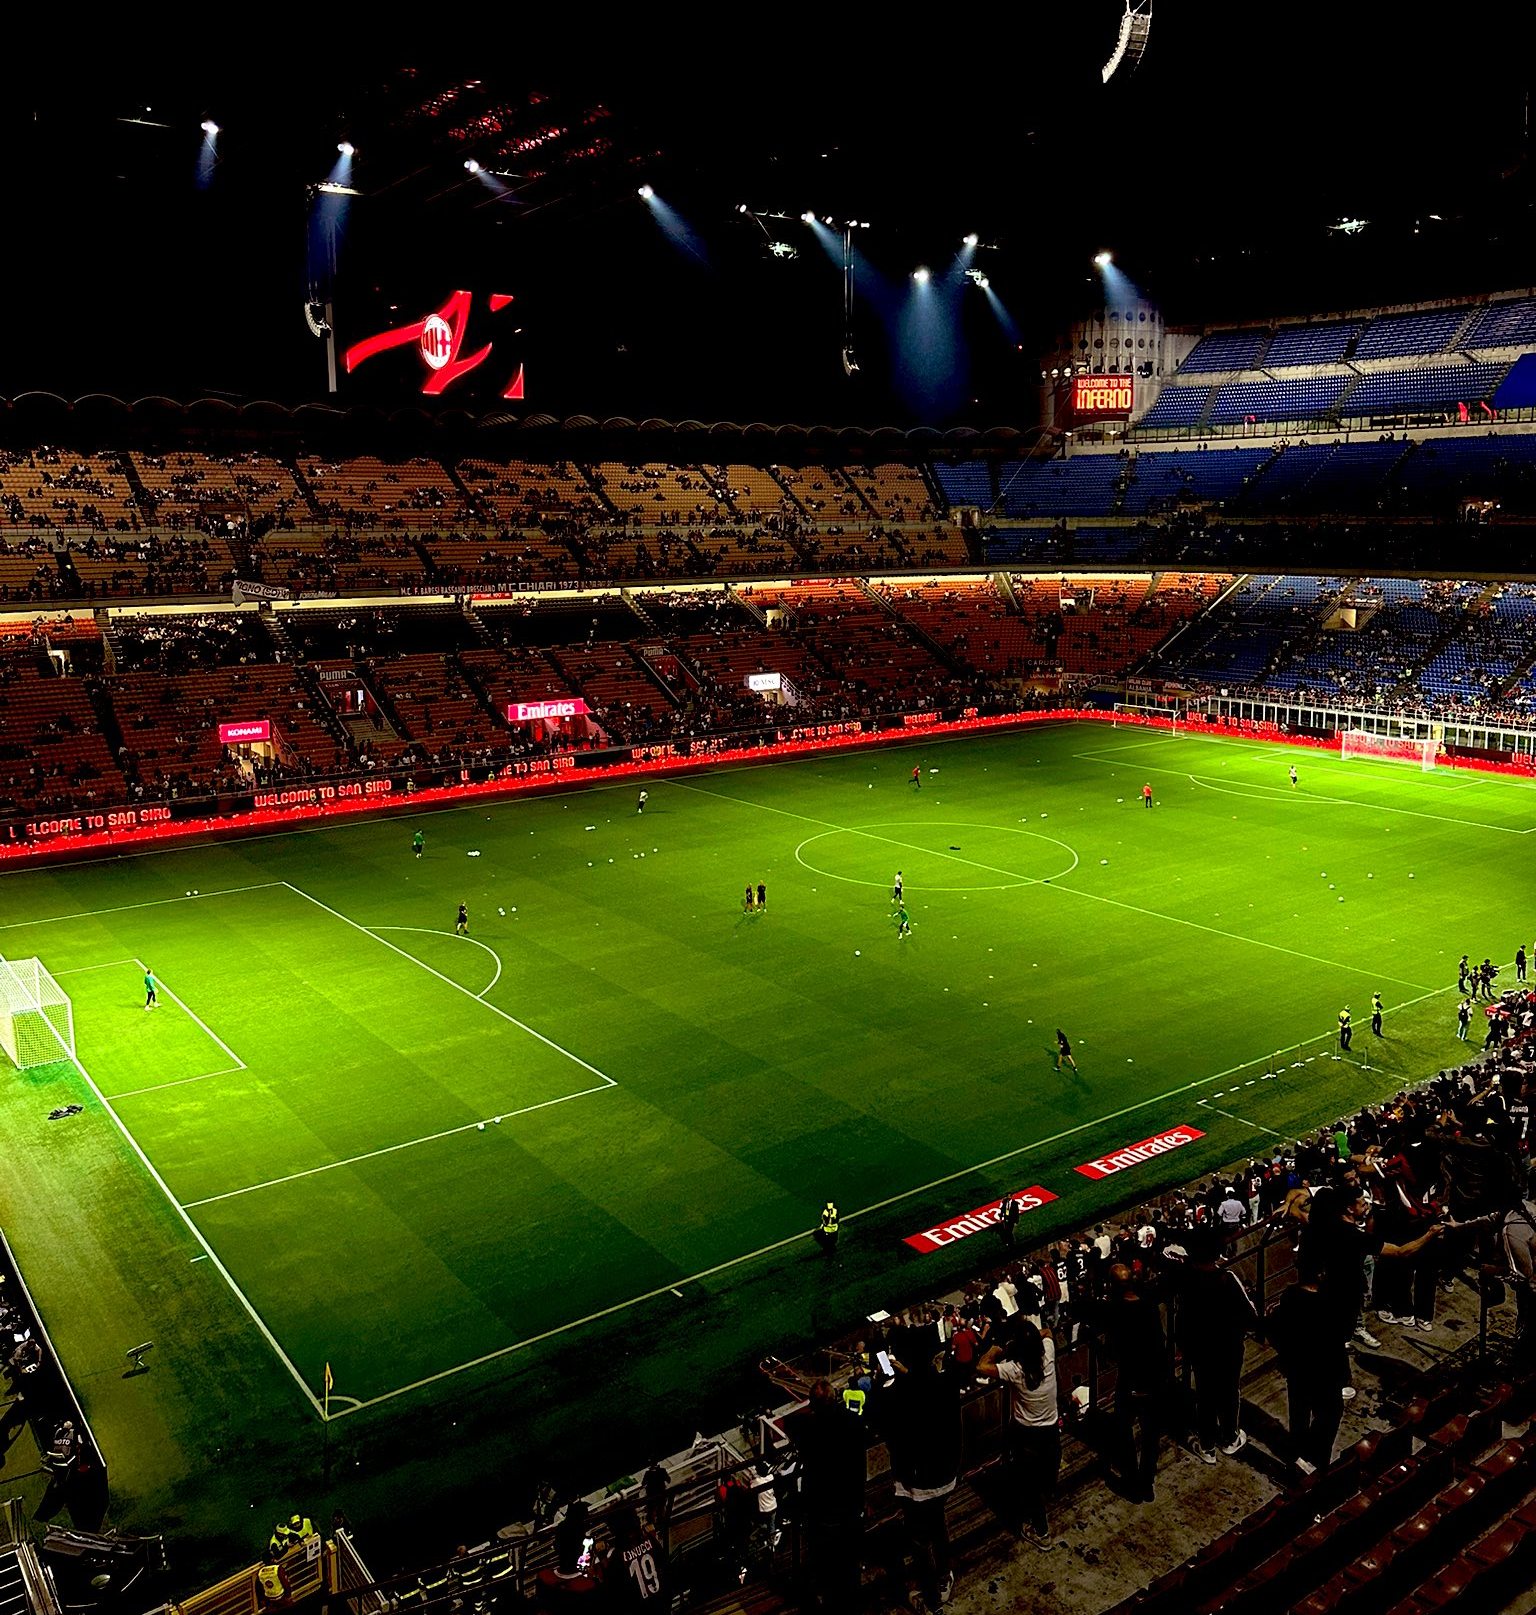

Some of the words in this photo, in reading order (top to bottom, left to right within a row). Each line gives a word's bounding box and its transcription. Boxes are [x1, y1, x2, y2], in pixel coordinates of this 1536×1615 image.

[1077, 378, 1108, 388] WELCOME
[1109, 378, 1118, 388] TO
[1119, 378, 1131, 388] THE
[1077, 389, 1131, 409] INFERNO
[441, 585, 466, 594] BASSANO
[467, 584, 496, 593] BRESCIANO
[520, 581, 556, 591] CHIARI
[559, 581, 579, 590] 1973
[319, 670, 347, 681] PUMA
[517, 702, 575, 720] Emirates
[816, 725, 827, 736] TO
[828, 723, 844, 735] SAN
[1227, 716, 1238, 727] TO
[227, 726, 262, 737] KONAMI
[530, 759, 551, 772] SAN
[552, 756, 575, 769] SIRO
[318, 786, 335, 799] TO
[338, 783, 362, 797] SAN
[365, 779, 392, 793] SIRO
[86, 815, 104, 829] TO
[108, 811, 136, 826] SAN
[140, 807, 172, 822] SIRO
[1088, 1131, 1193, 1175] Emirates
[921, 1194, 1043, 1247] Emiraes
[629, 1553, 660, 1599] 19
